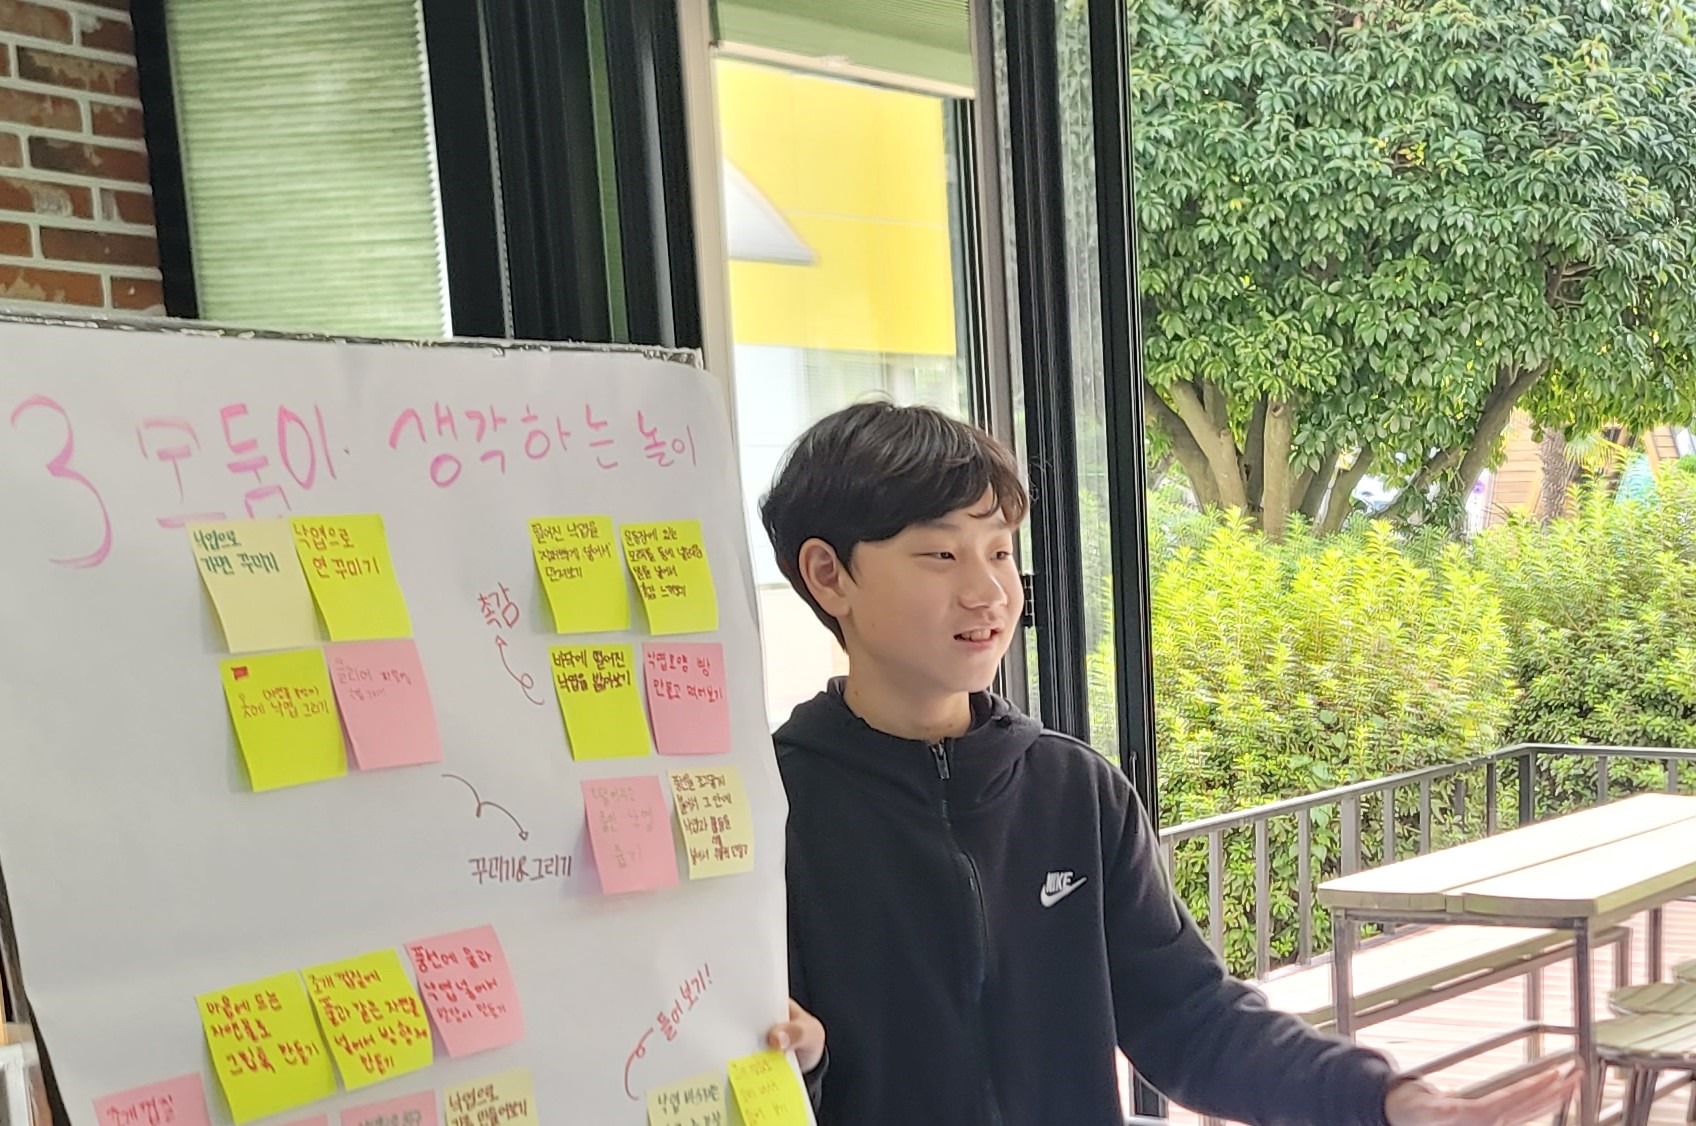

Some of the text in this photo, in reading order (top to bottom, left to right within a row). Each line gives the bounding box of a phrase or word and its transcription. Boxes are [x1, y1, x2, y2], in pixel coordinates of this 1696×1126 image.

[10, 394, 114, 569] 3
[389, 403, 620, 488] 생각하는
[636, 407, 697, 468] 놀이
[293, 523, 355, 551] 낙엽으로
[531, 520, 600, 545] 떨어진 낙엽을
[624, 528, 659, 547] 운동장에
[201, 551, 281, 575] 가면 꾸미기
[312, 555, 381, 580] 연 꾸미기
[477, 583, 520, 630] 촉감
[551, 649, 626, 671] 바닥에 떨어진
[556, 671, 589, 693] 낙엽을
[653, 678, 682, 700] 만들고
[302, 699, 330, 718] 그리기
[1045, 870, 1074, 894] NIKE
[412, 946, 459, 973] 풍선에
[277, 1040, 320, 1066] 만들기
[359, 1052, 395, 1075] 만들기
